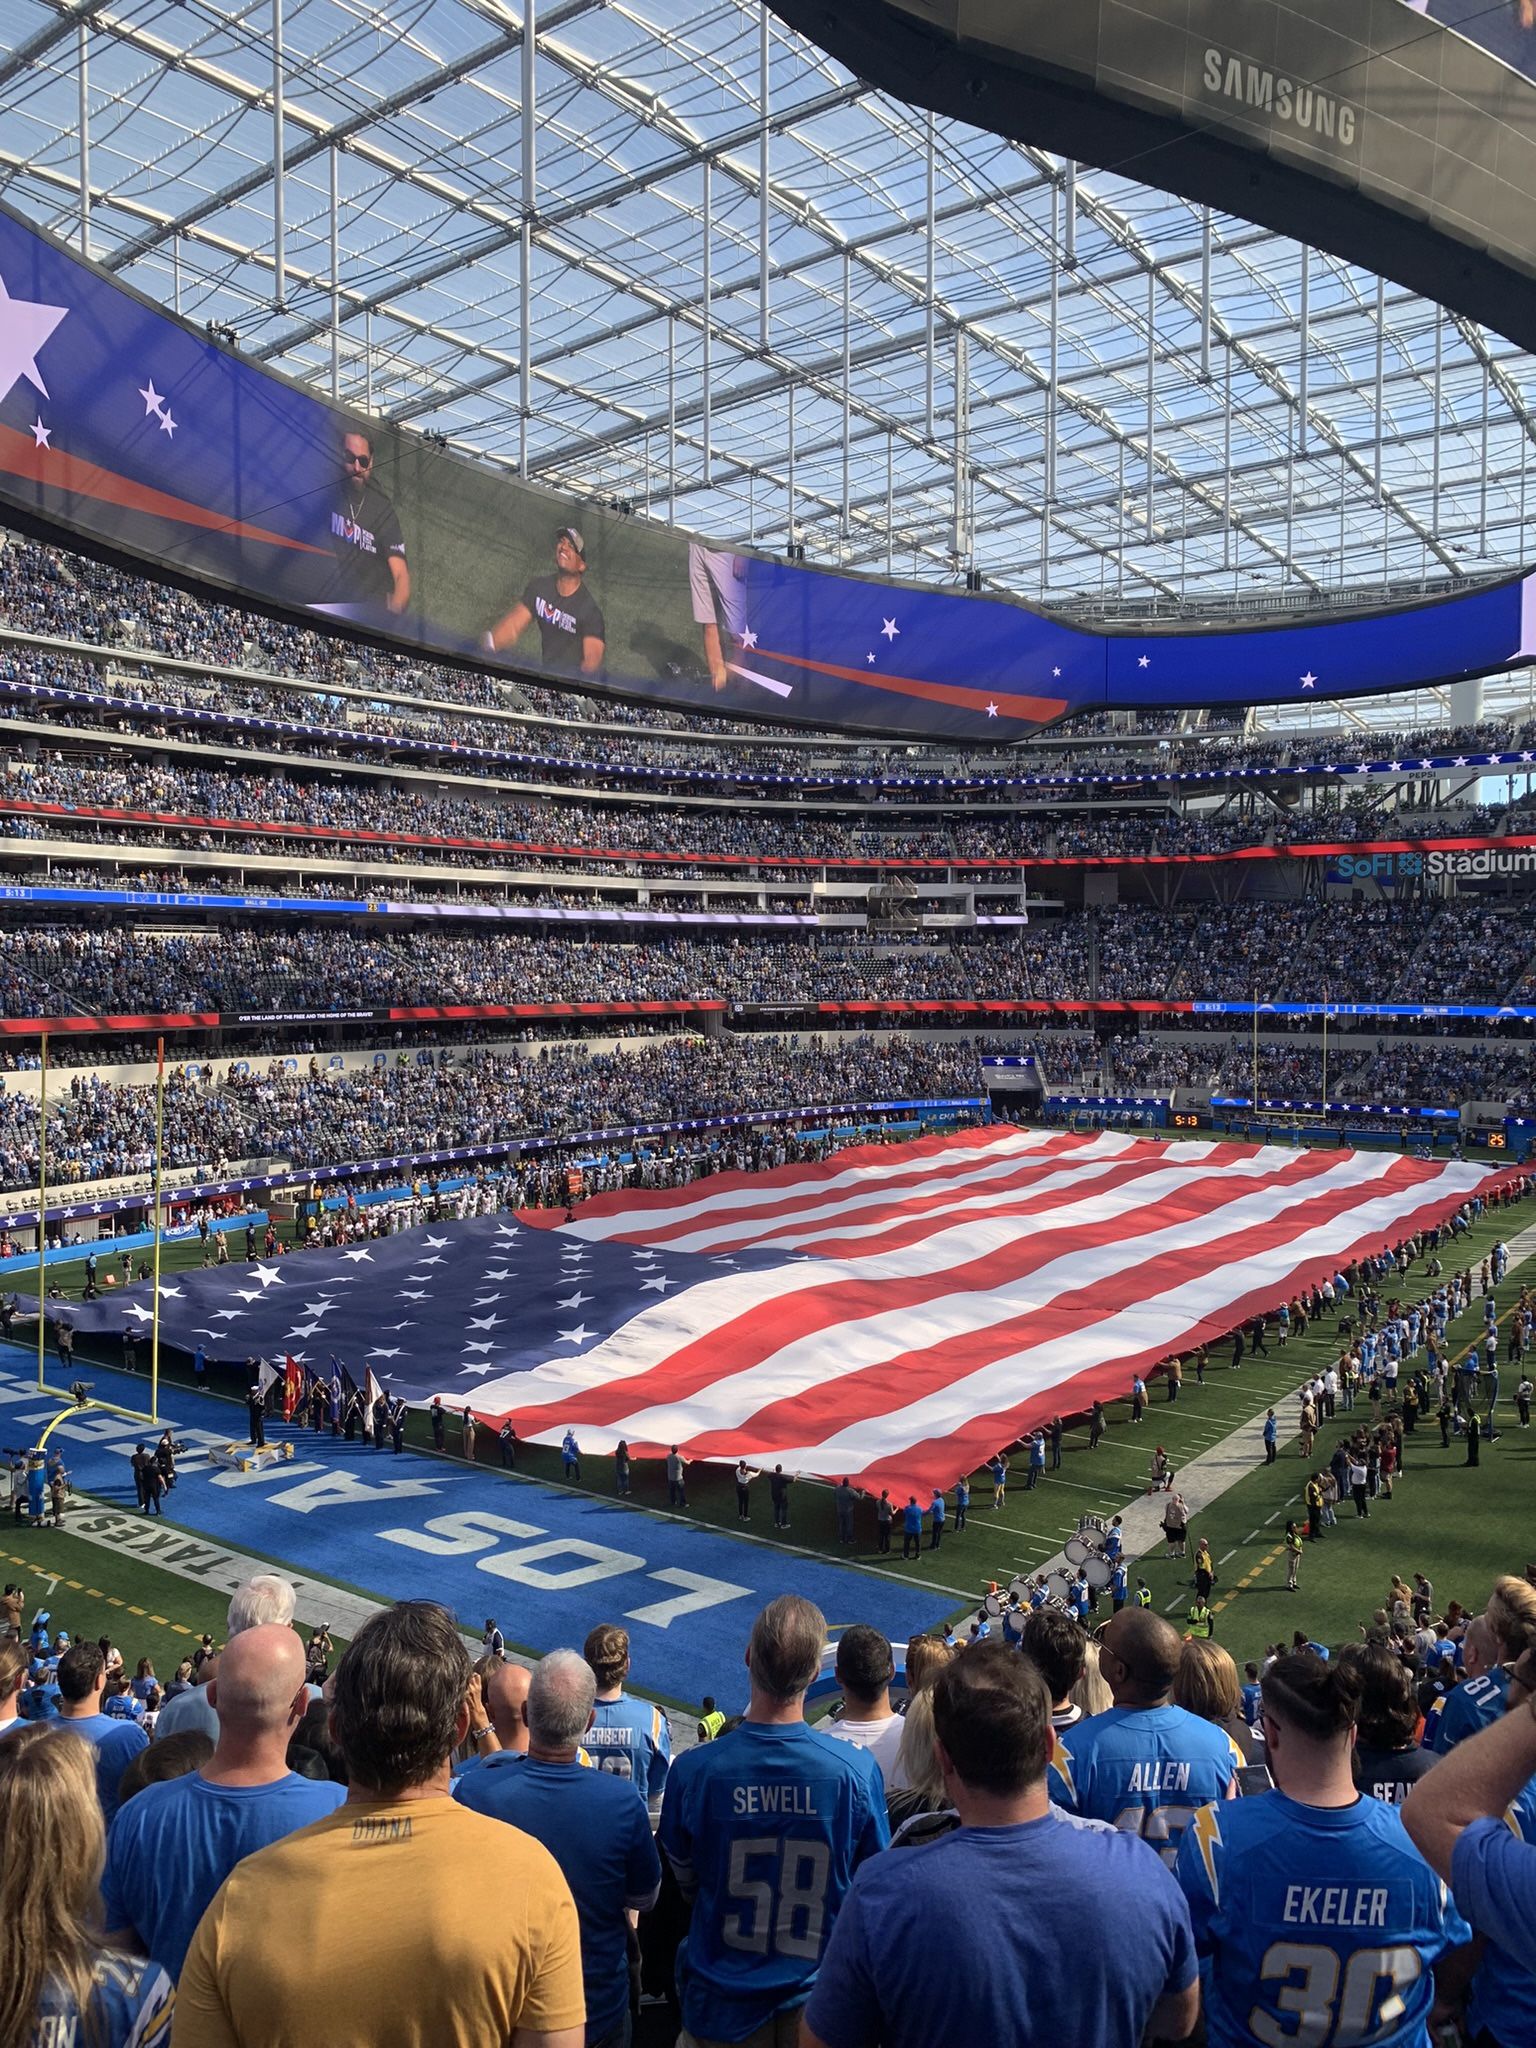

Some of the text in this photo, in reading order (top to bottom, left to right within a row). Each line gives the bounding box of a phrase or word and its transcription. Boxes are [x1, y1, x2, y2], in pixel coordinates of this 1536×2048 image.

[1203, 49, 1356, 146] SAMSUNG
[1409, 771, 1436, 779] PEPSI
[1337, 849, 1536, 878] SoFi Stadium
[6, 889, 25, 897] 5:13
[1175, 1115, 1198, 1126] 5:13
[1489, 1134, 1504, 1146] 25
[77, 1515, 234, 1575] TAKES
[374, 1511, 757, 1629] LOS
[1463, 1675, 1501, 1707] 81
[582, 1727, 633, 1746] HERBERT
[1128, 1761, 1190, 1792] ALLEN
[733, 1785, 817, 1815] SEWELL
[1373, 1782, 1416, 1805] SEA
[722, 1837, 831, 1961] 58
[1282, 1885, 1389, 1927] EKELER
[1248, 1941, 1422, 2048] 30
